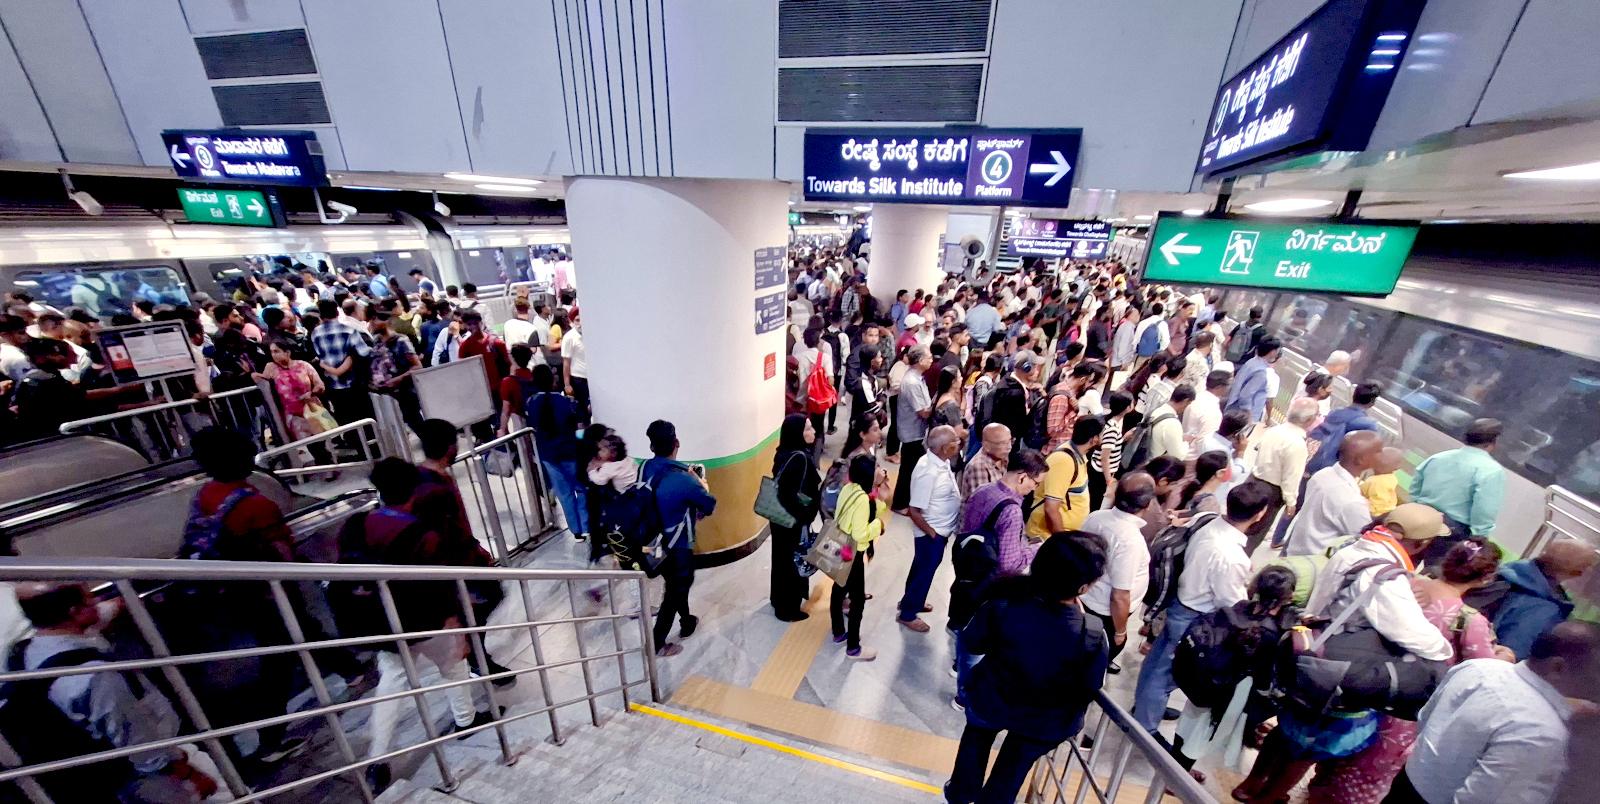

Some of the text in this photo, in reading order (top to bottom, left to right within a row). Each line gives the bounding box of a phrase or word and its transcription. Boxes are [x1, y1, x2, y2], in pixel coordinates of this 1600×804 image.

[841, 138, 968, 171] ರೇಷ್ಮೆ ಸಂಸ್ಥೆ ಕಡೆಗೆ
[990, 156, 1003, 179] 4
[807, 176, 964, 196] Towards Silk Institute
[975, 184, 1013, 197] Platform
[1285, 228, 1387, 255] ನಿರ್ಗಮನ
[1274, 260, 1312, 279] Exit
